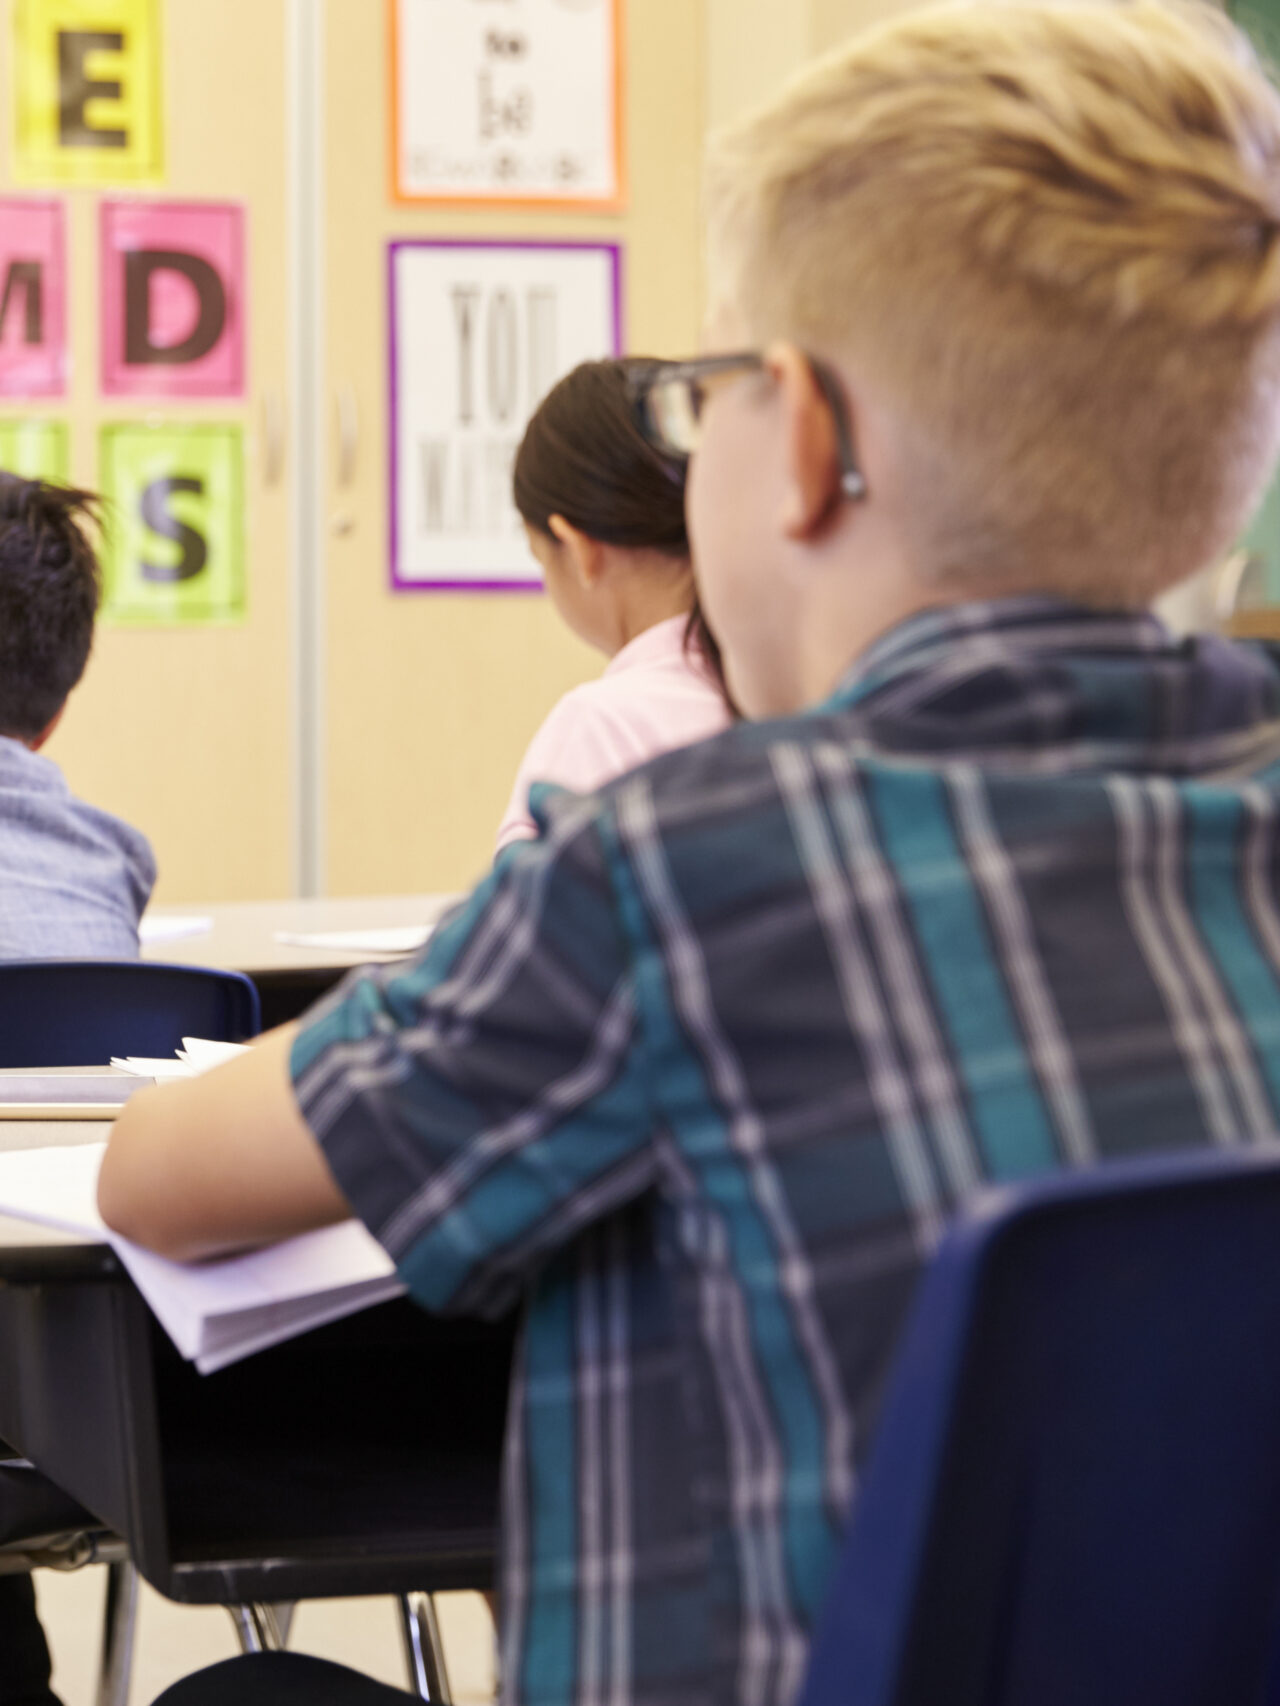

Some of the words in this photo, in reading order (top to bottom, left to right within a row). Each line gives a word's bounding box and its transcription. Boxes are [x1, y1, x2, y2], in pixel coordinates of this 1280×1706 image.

[56, 30, 128, 148] E
[121, 247, 229, 366] D
[137, 477, 211, 583] S
